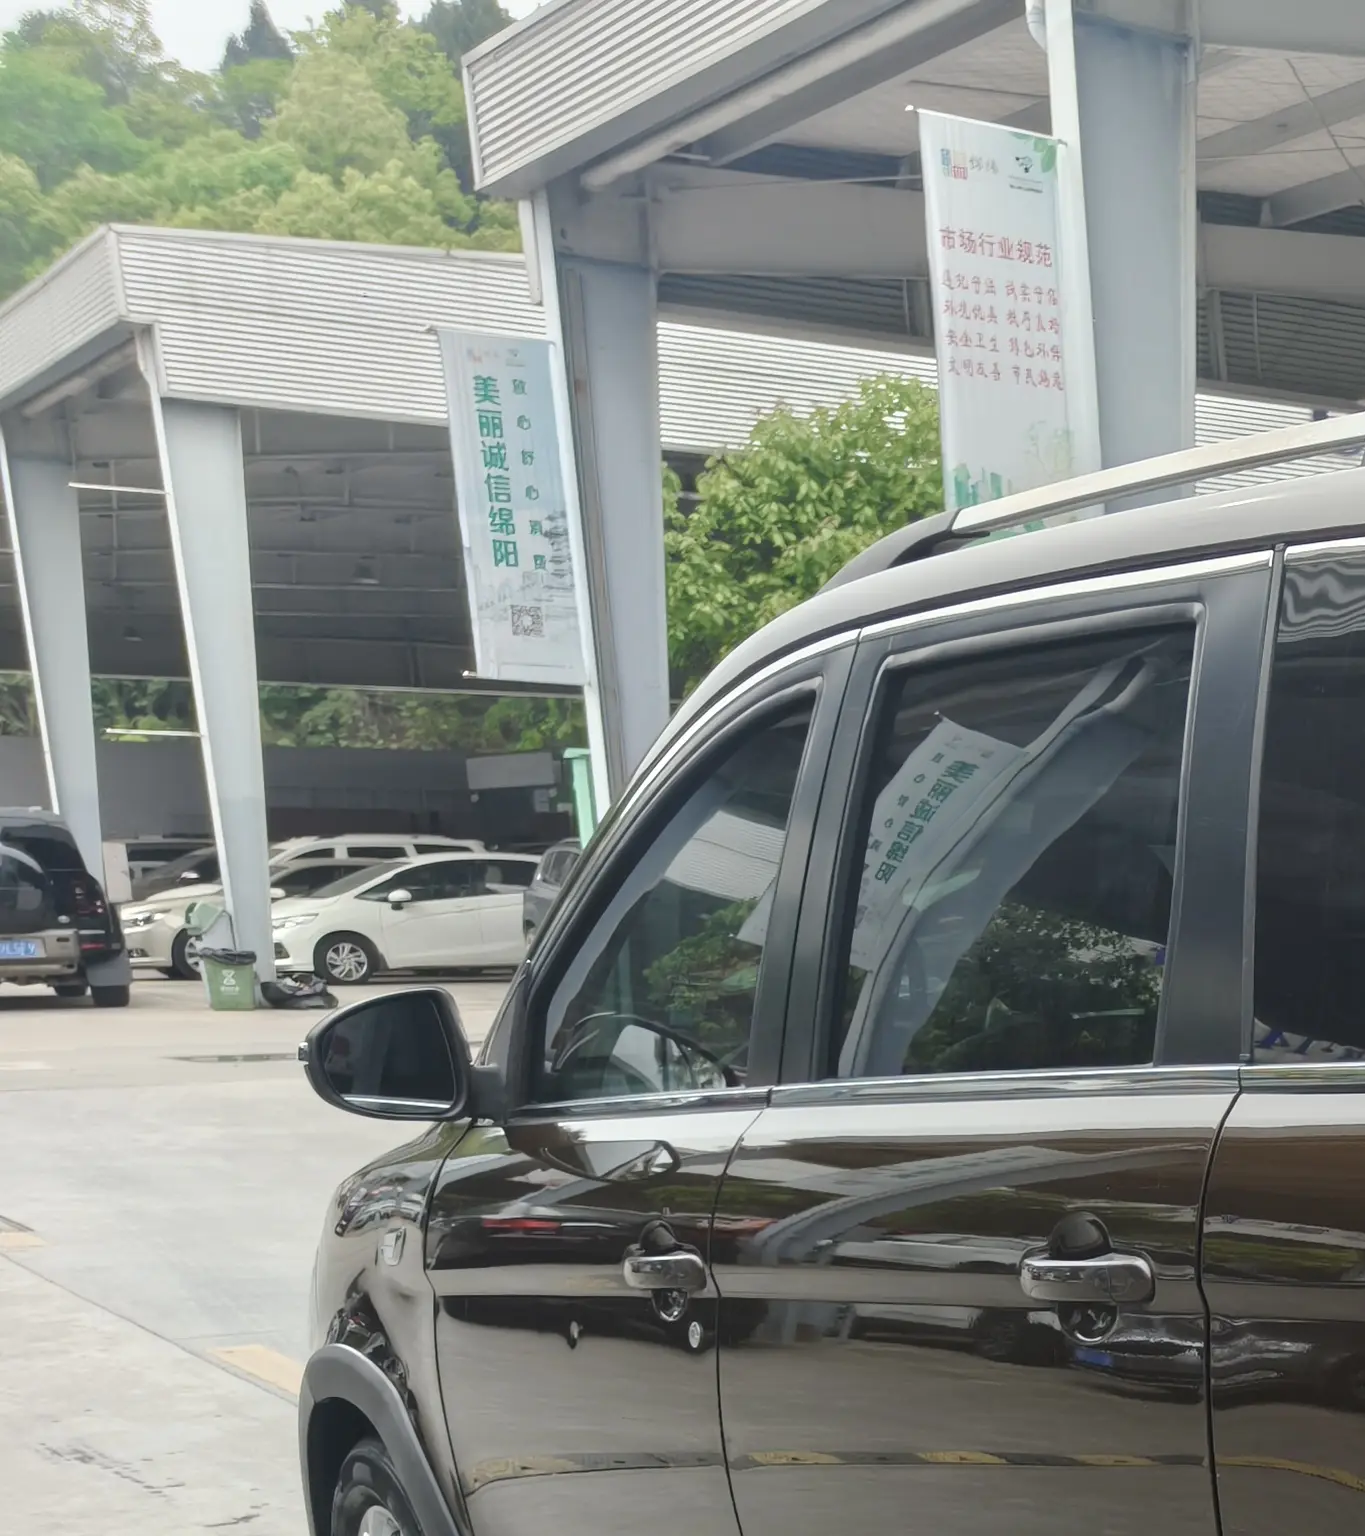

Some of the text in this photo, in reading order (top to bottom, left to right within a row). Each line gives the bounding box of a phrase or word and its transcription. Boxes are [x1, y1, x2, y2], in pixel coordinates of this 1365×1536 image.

[939, 226, 1053, 267] 市场行业规范
[472, 375, 519, 568] 美丽诚信绵阳
